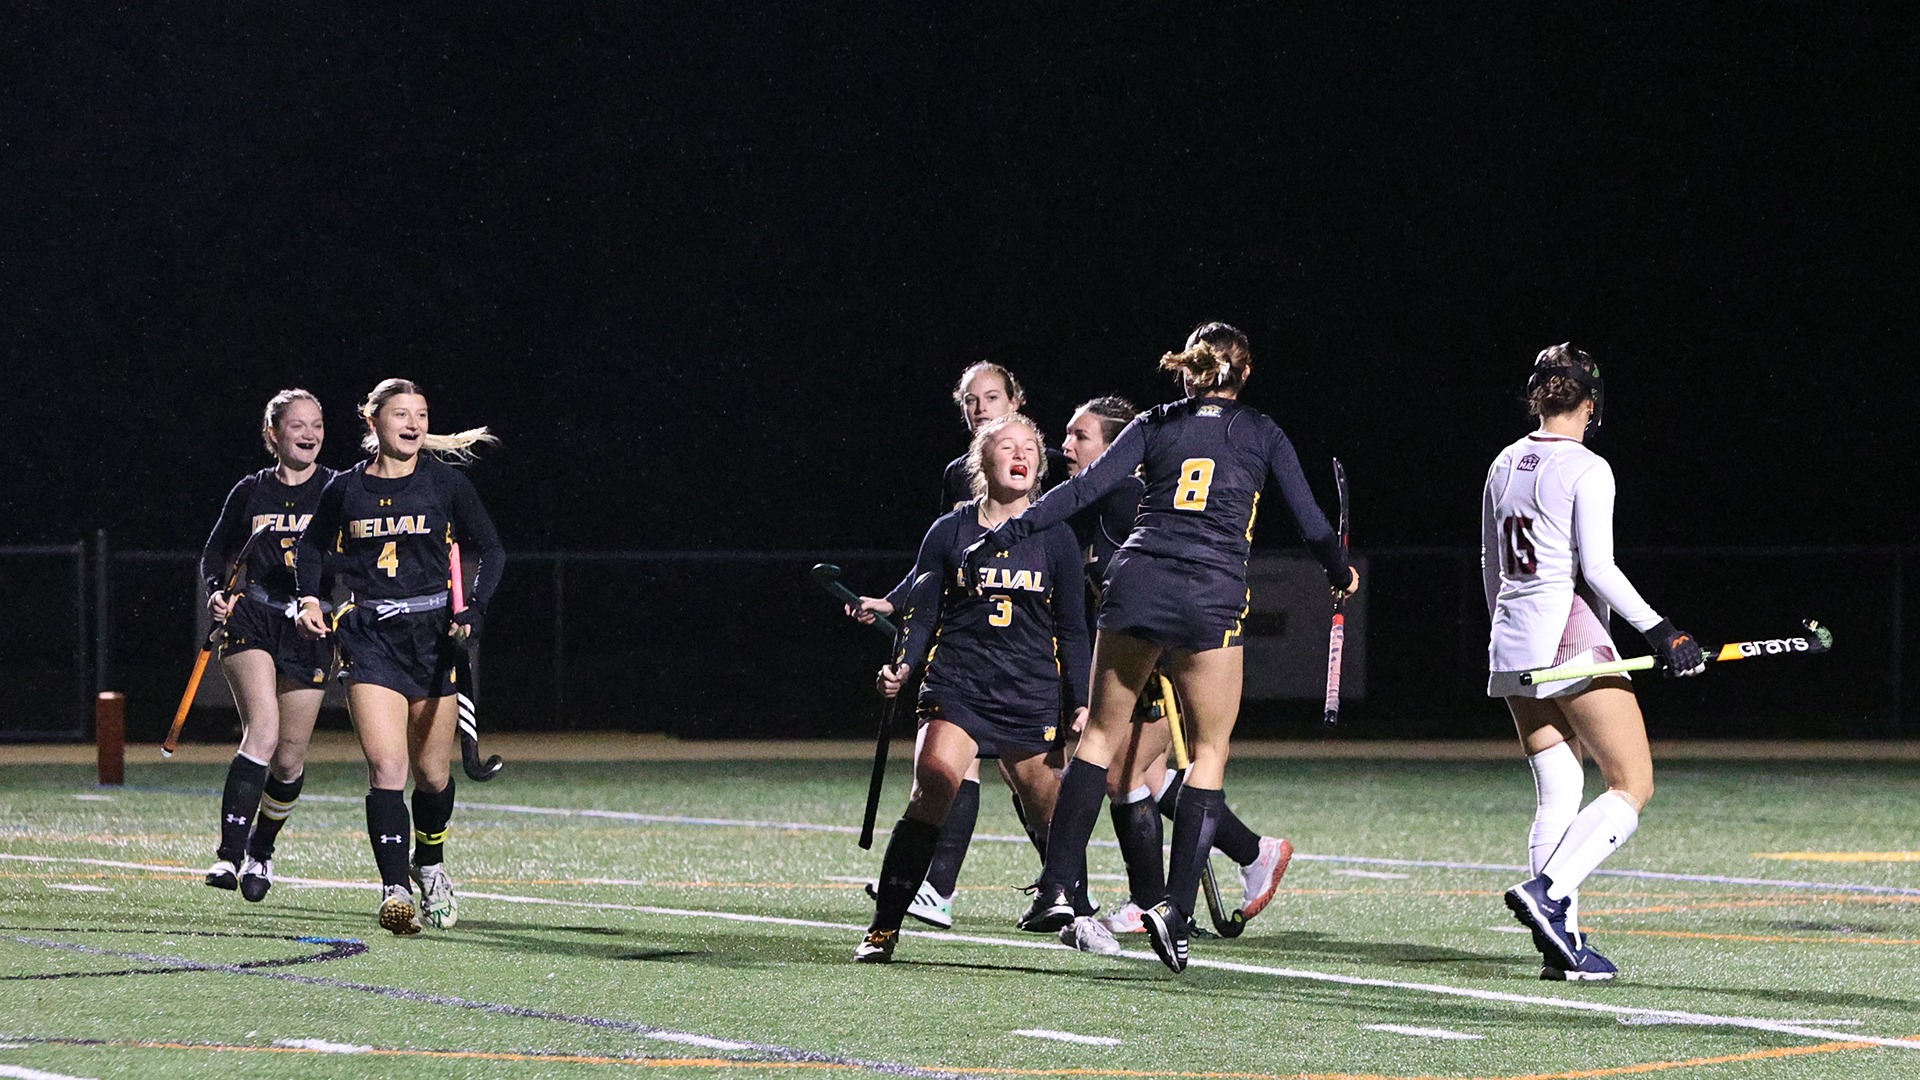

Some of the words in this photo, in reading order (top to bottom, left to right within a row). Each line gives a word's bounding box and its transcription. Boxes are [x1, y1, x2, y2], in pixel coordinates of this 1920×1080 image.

[1518, 462, 1536, 470] MAC
[1174, 458, 1215, 511] 8
[252, 514, 313, 535] DELVA
[349, 515, 431, 538] DELVAL
[377, 541, 399, 577] 4
[1503, 516, 1537, 575] 15
[957, 567, 1045, 592] LVAL
[988, 594, 1013, 627] 3
